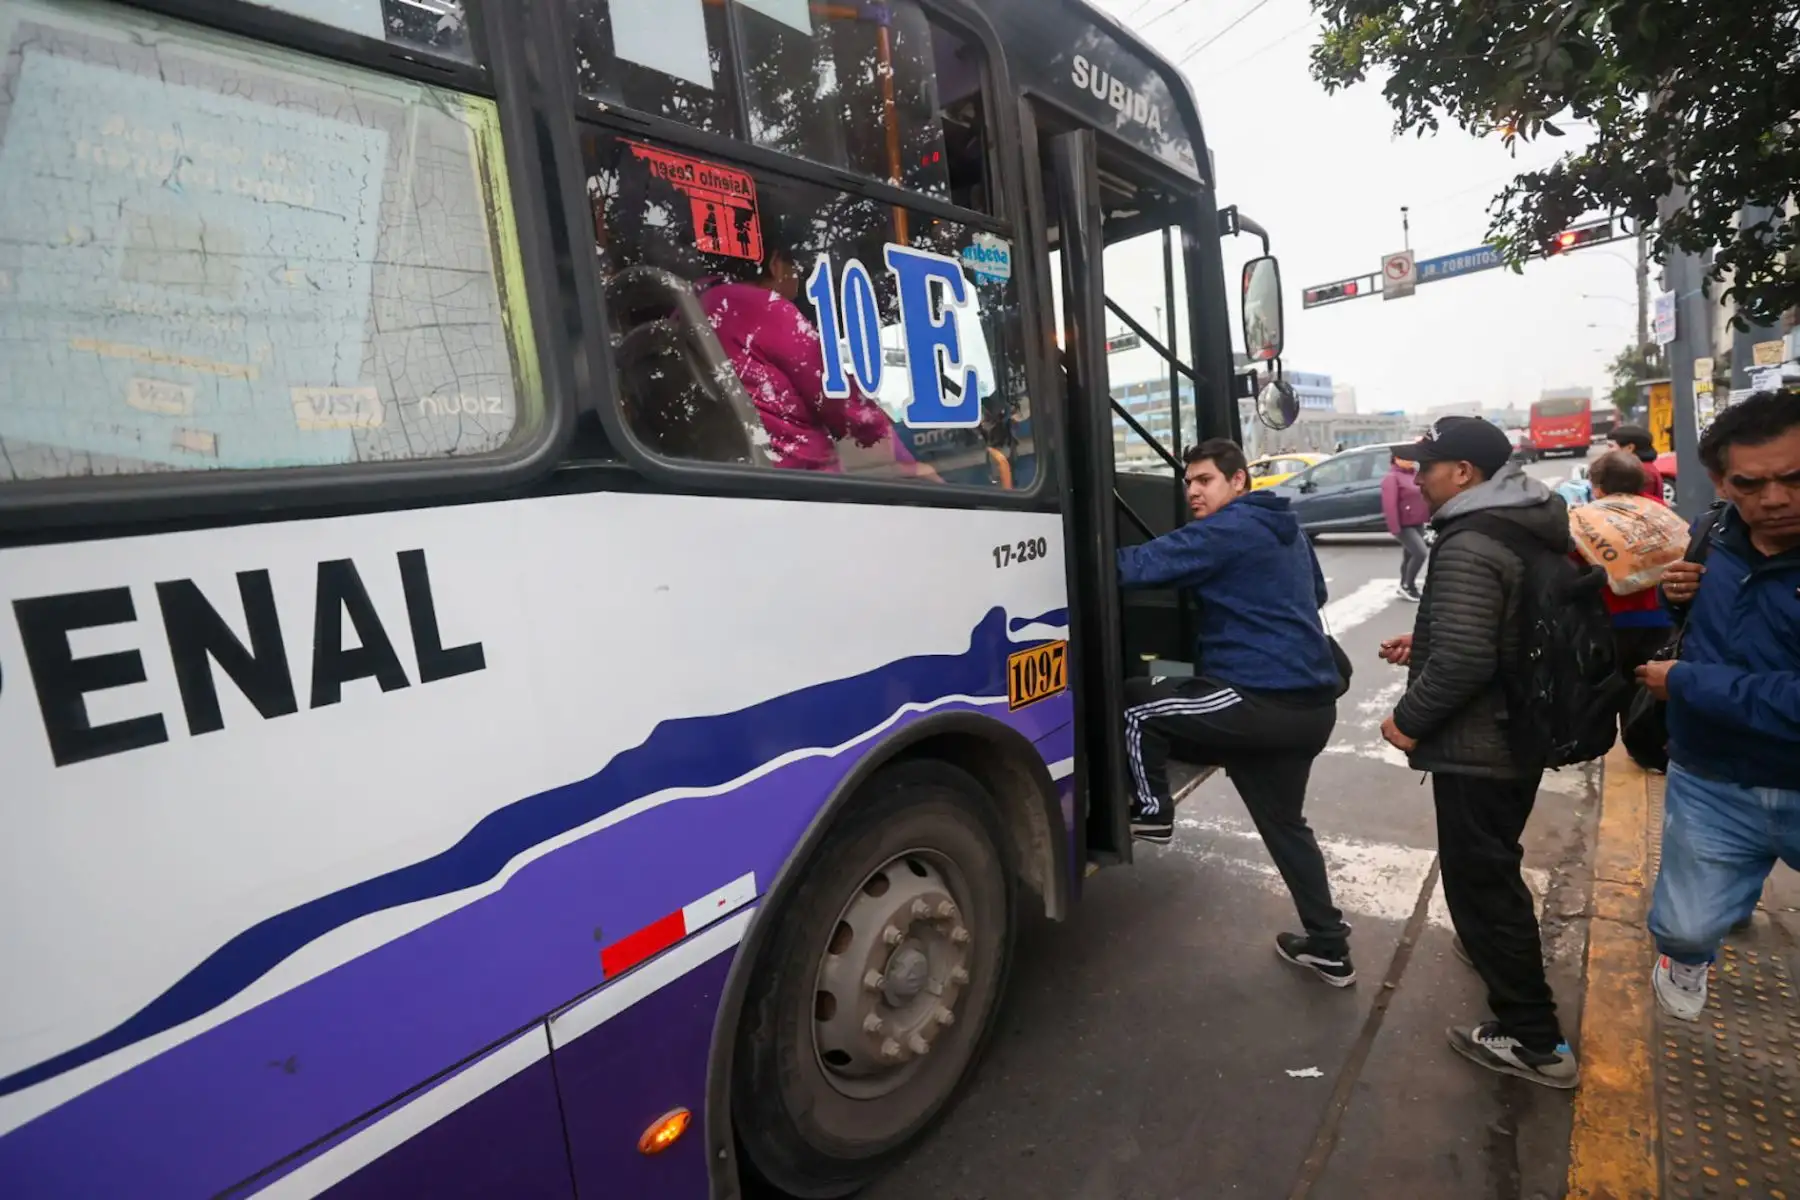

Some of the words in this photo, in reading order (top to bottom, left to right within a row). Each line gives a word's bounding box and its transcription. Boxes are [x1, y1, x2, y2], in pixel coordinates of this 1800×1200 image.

[1071, 54, 1162, 134] SUBIDA
[1442, 251, 1498, 274] ZORRITOS
[805, 253, 886, 400] 10
[884, 243, 982, 428] E
[420, 394, 503, 417] niubiz
[992, 536, 1047, 568] 17-230
[0, 548, 487, 768] ENAL
[1012, 647, 1064, 701] 1097
